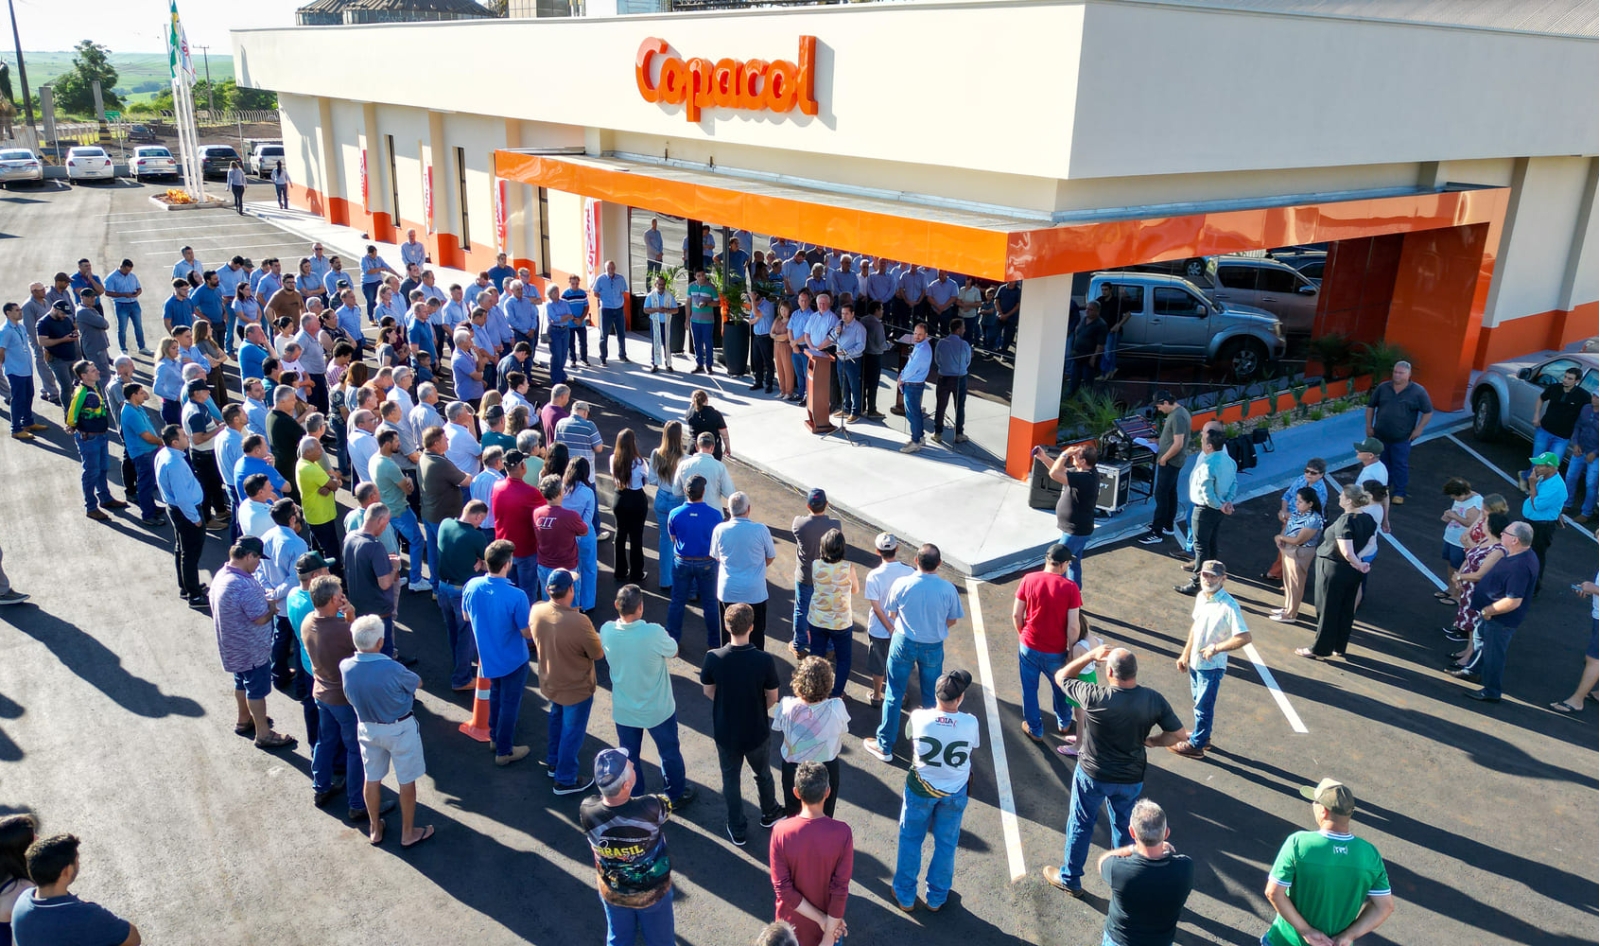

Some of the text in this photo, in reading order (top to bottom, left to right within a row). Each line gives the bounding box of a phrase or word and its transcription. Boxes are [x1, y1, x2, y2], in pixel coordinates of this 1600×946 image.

[635, 35, 818, 122] Copacol
[535, 516, 557, 527] CIT
[918, 736, 969, 768] 26
[597, 845, 644, 857] BRASIL
